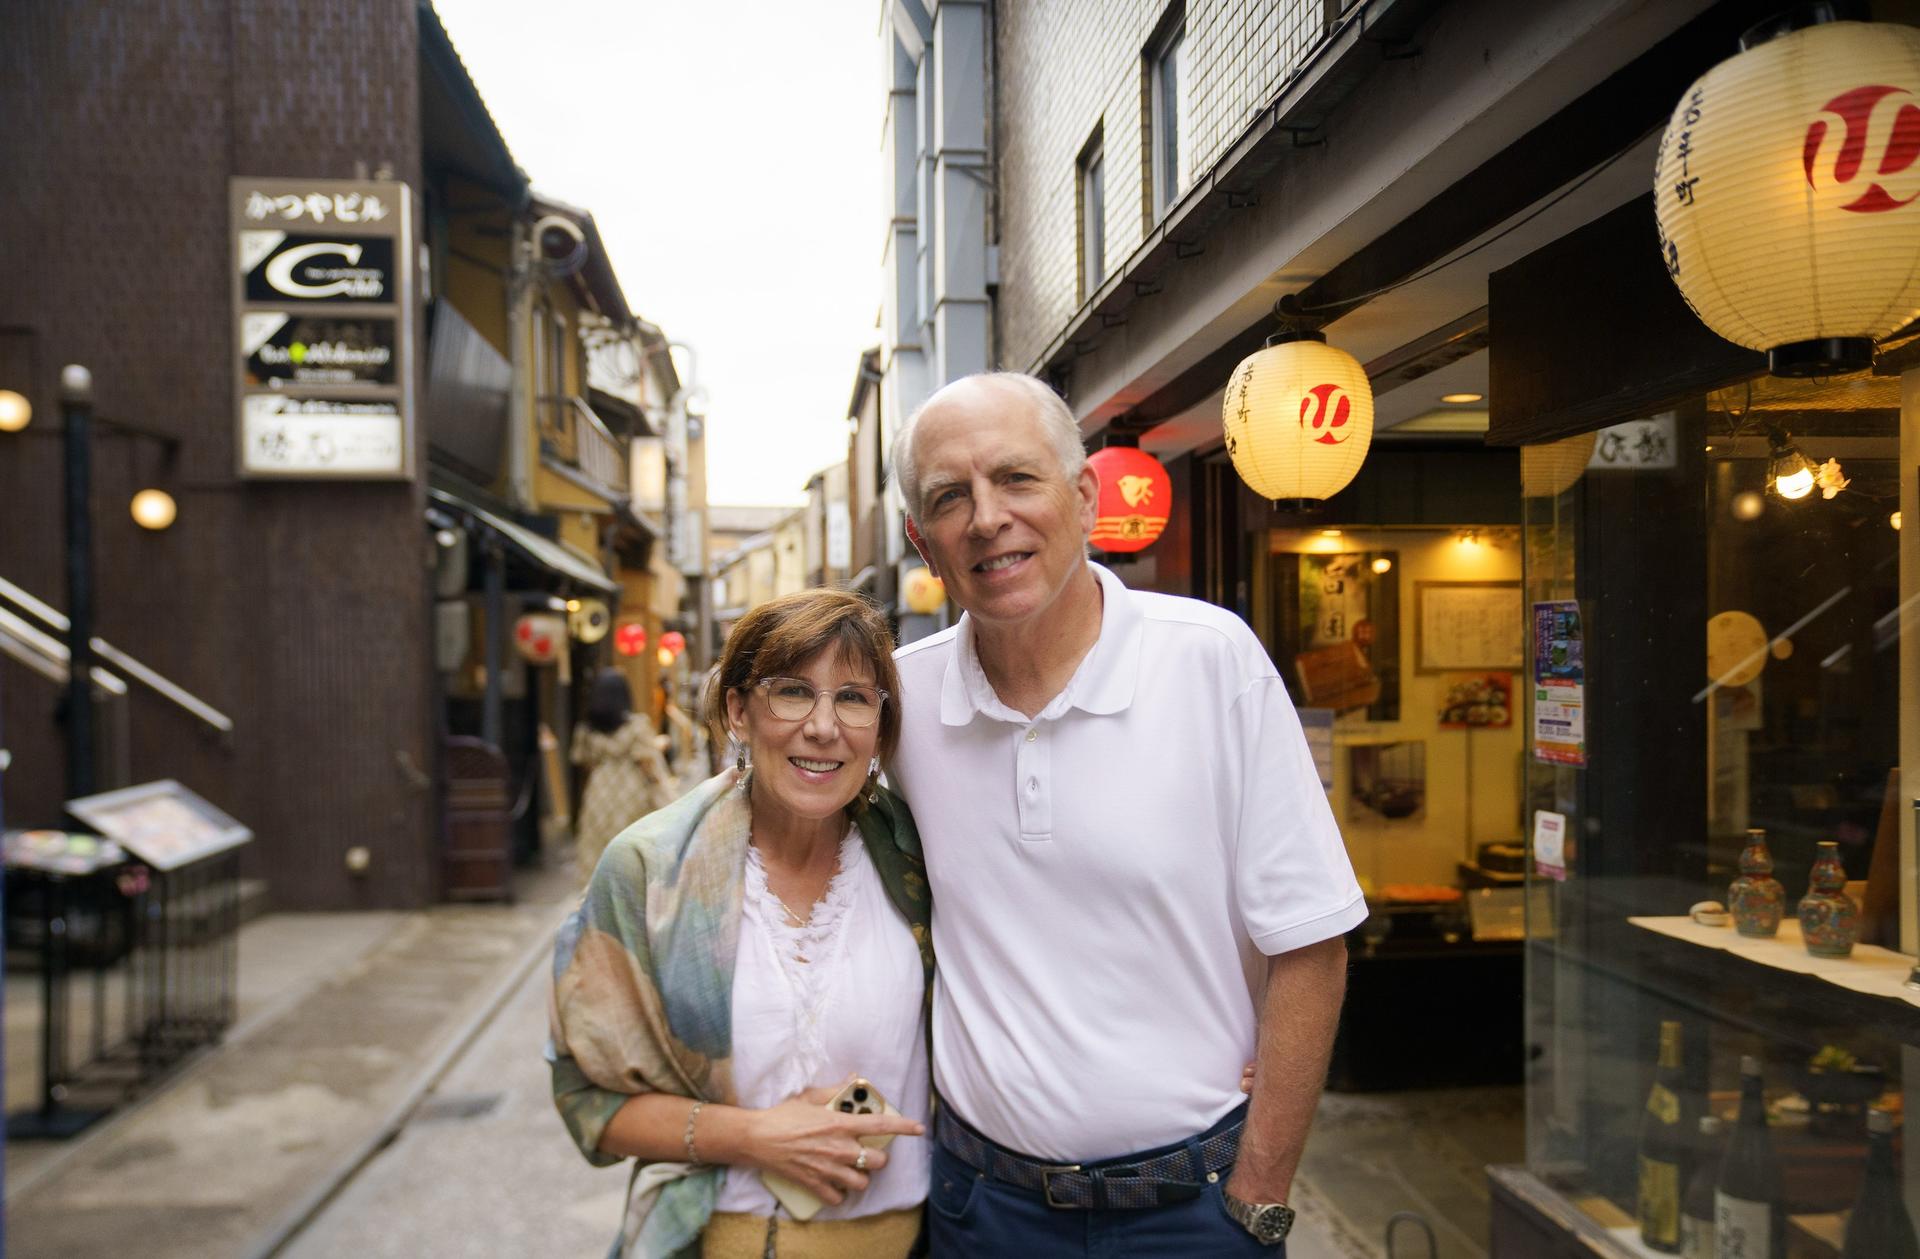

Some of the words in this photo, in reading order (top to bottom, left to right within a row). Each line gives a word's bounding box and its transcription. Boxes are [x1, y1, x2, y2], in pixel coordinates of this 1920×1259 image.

[245, 191, 389, 223] かつやビル
